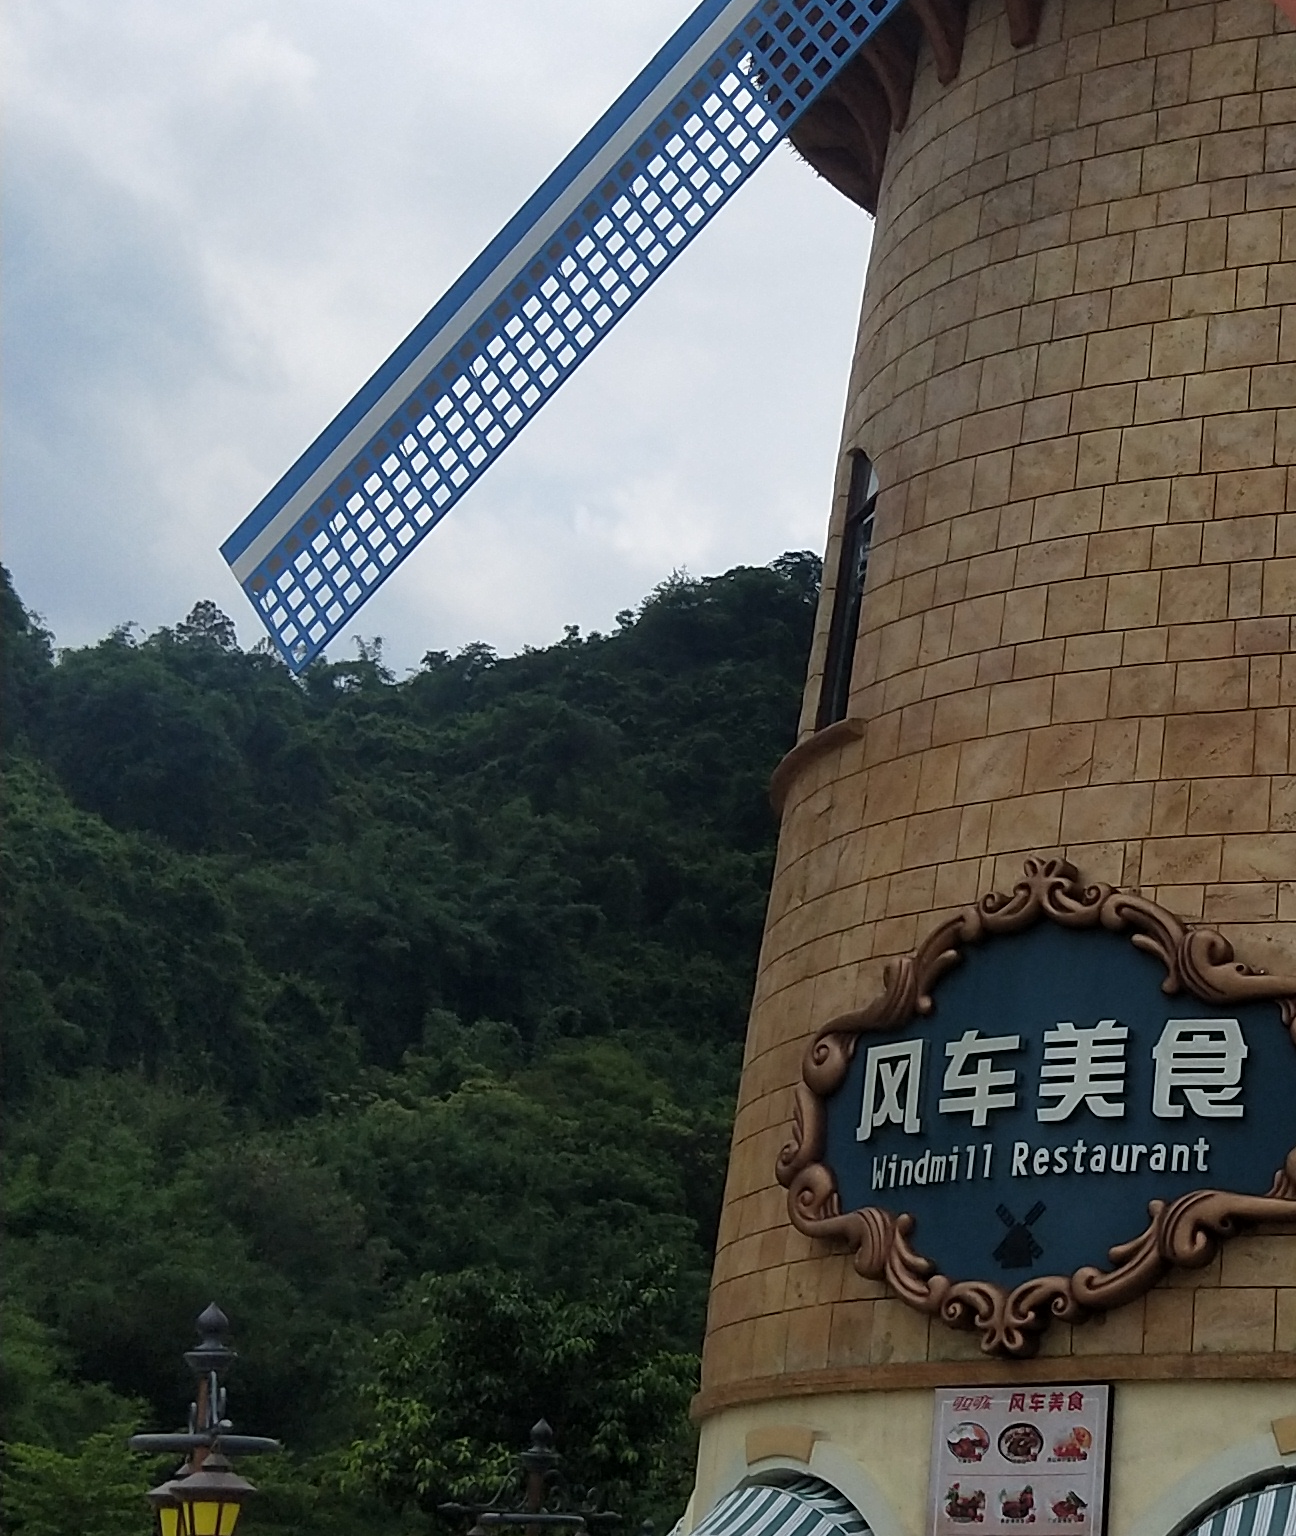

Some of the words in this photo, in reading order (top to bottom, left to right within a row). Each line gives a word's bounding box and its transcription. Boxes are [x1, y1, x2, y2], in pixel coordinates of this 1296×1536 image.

[856, 1017, 1249, 1142] 风车美食
[871, 1143, 993, 1191] Windmill
[1011, 1136, 1211, 1177] Restaurant
[1009, 1391, 1084, 1412] 风车美食
